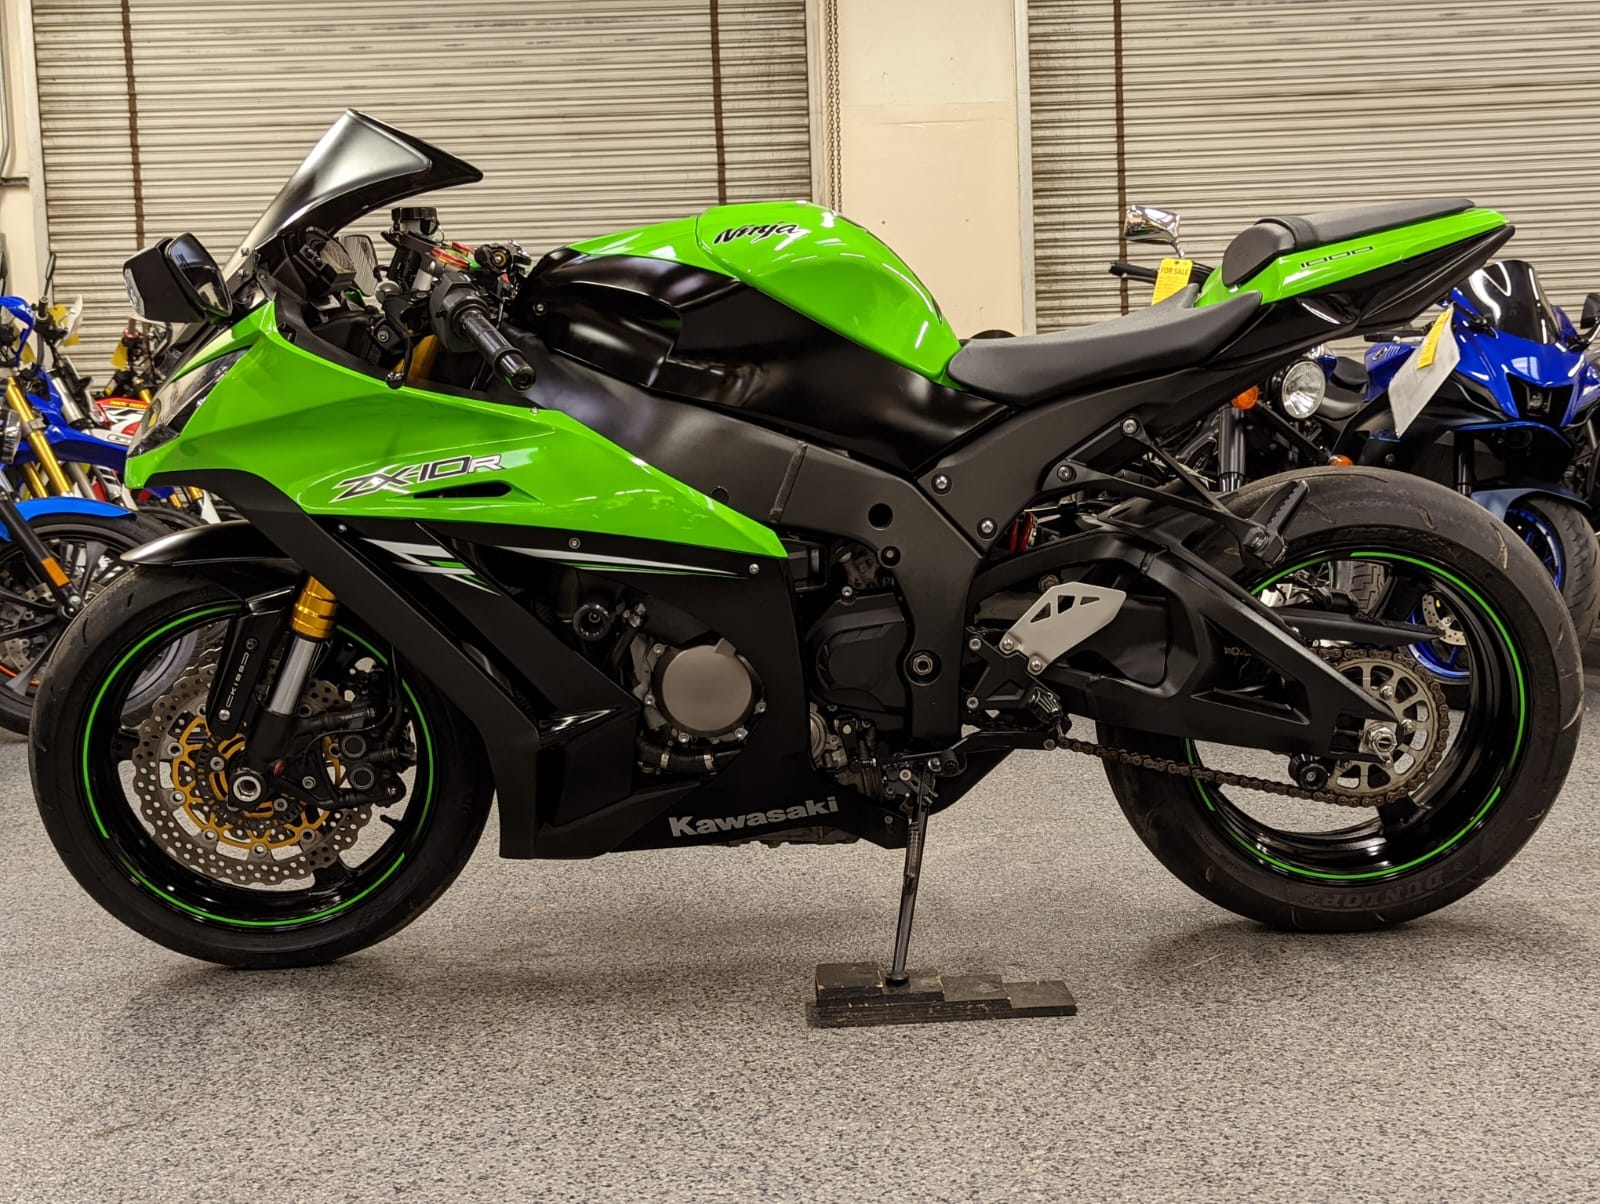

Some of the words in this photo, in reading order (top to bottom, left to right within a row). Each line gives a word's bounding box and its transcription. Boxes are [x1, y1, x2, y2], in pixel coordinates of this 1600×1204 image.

[713, 221, 799, 244] Ninja
[1300, 245, 1374, 269] 1000
[328, 453, 506, 503] ZX-10R
[668, 796, 839, 838] Kawasaki
